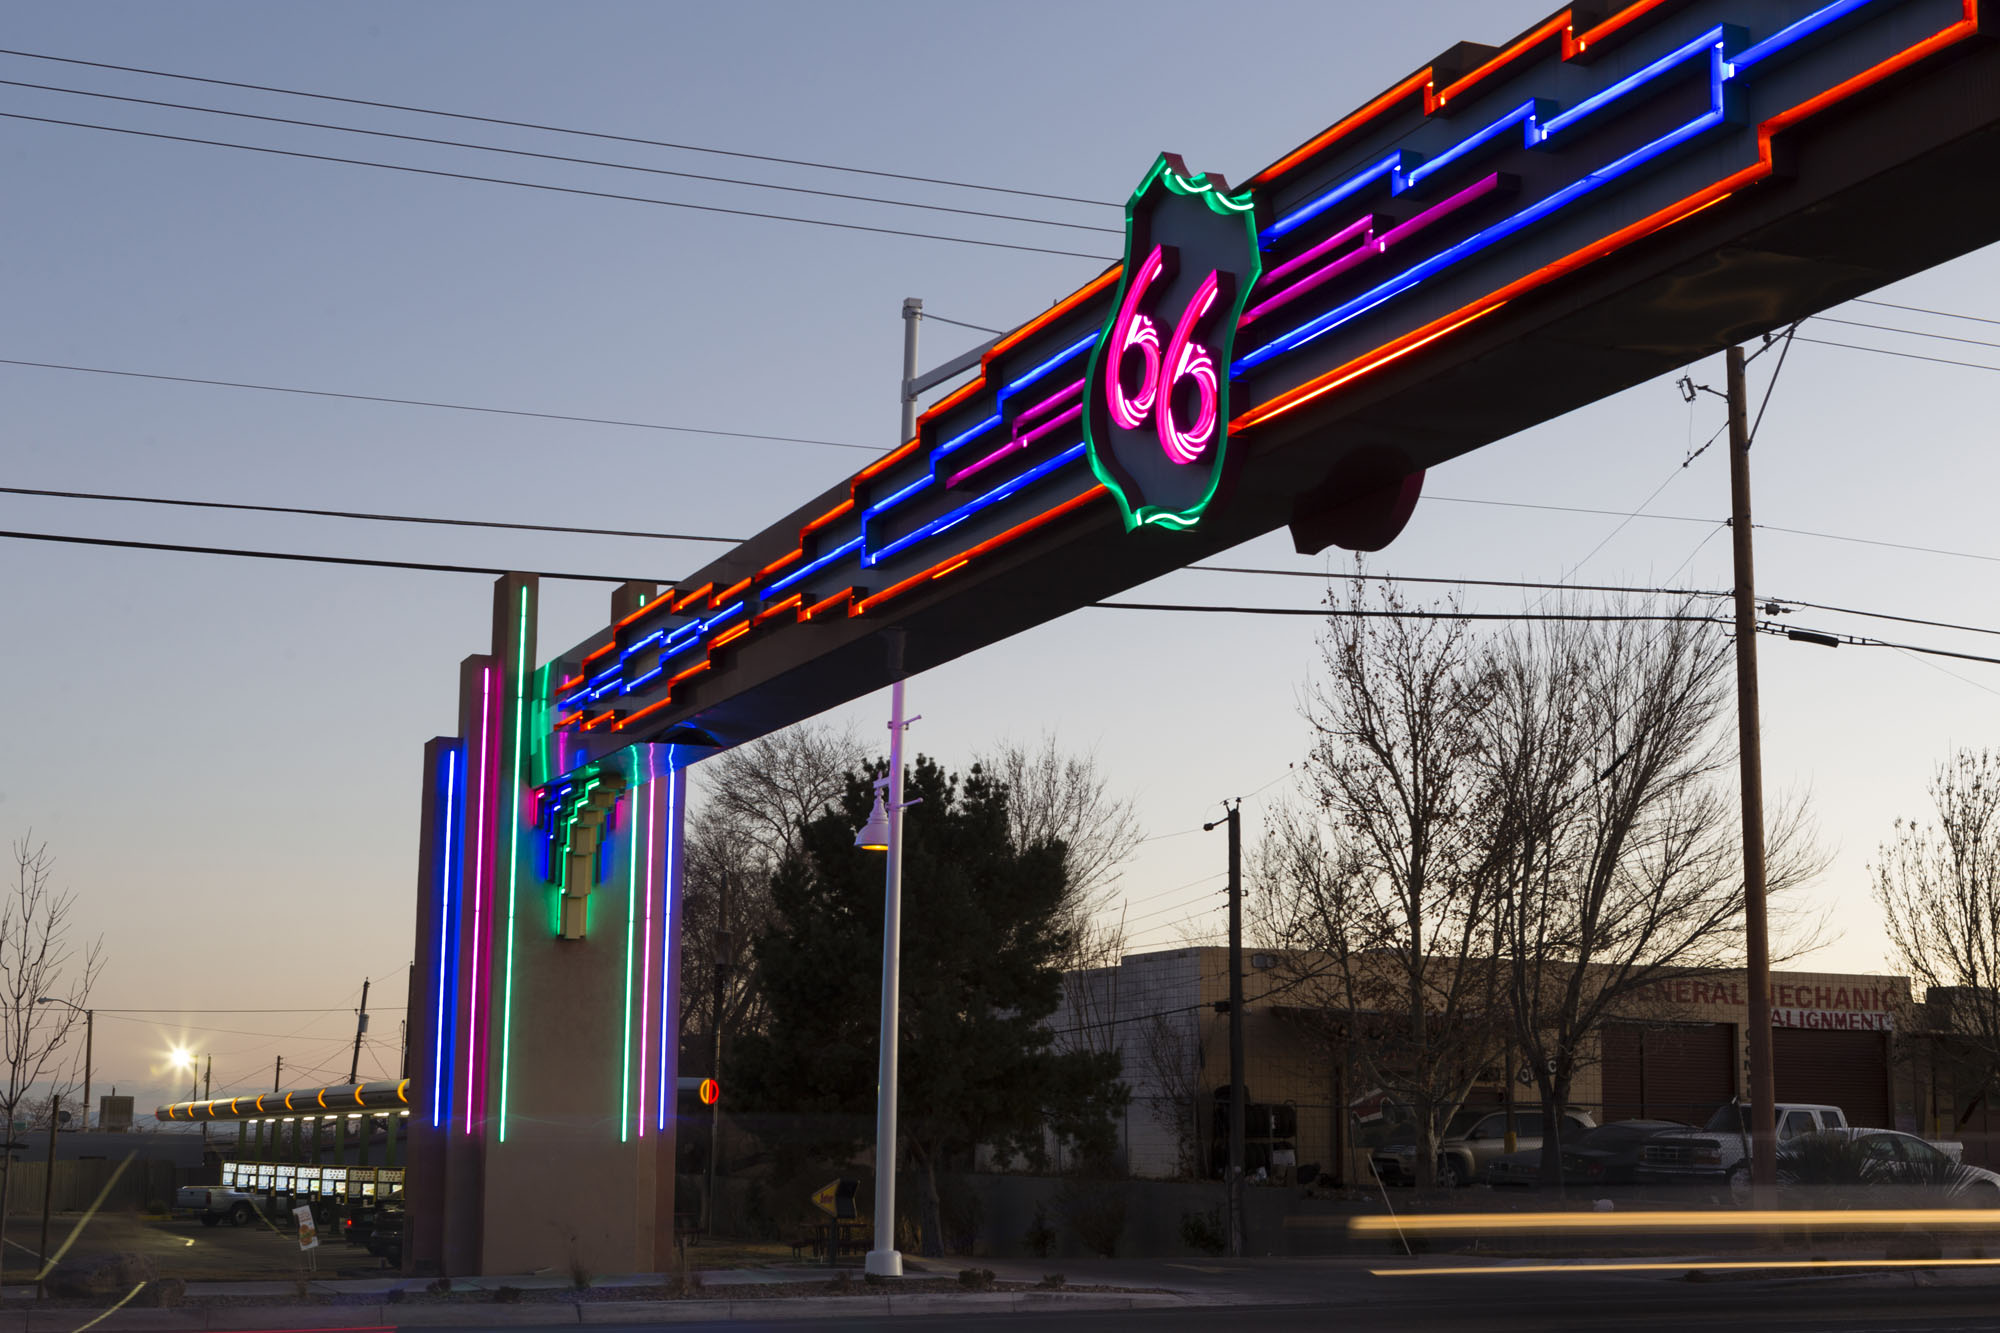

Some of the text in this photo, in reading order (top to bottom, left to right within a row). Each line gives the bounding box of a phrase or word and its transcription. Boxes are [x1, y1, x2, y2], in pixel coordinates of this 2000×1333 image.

[1106, 244, 1218, 465] 66
[1770, 984, 1897, 1011] ECHANIC
[1771, 1009, 1885, 1030] ALIGNMENT
